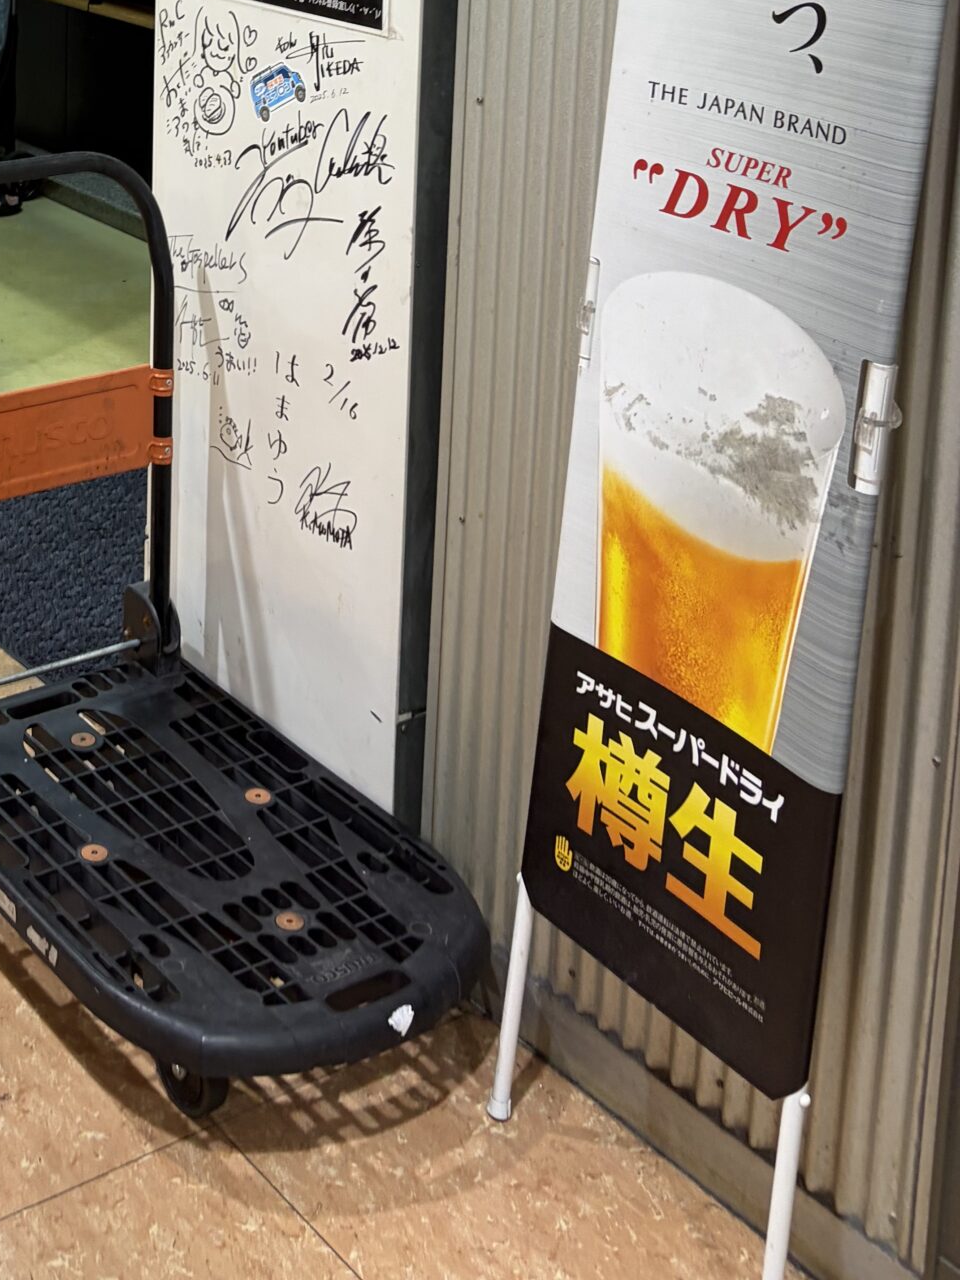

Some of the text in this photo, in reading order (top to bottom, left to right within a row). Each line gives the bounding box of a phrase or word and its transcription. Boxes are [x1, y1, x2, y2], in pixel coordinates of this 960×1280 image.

[648, 81, 847, 146] THE JAPAN BRAND
[706, 146, 792, 189] SUPER
[576, 670, 786, 824] アサヒスーパードライ
[565, 712, 764, 961] 樽生
